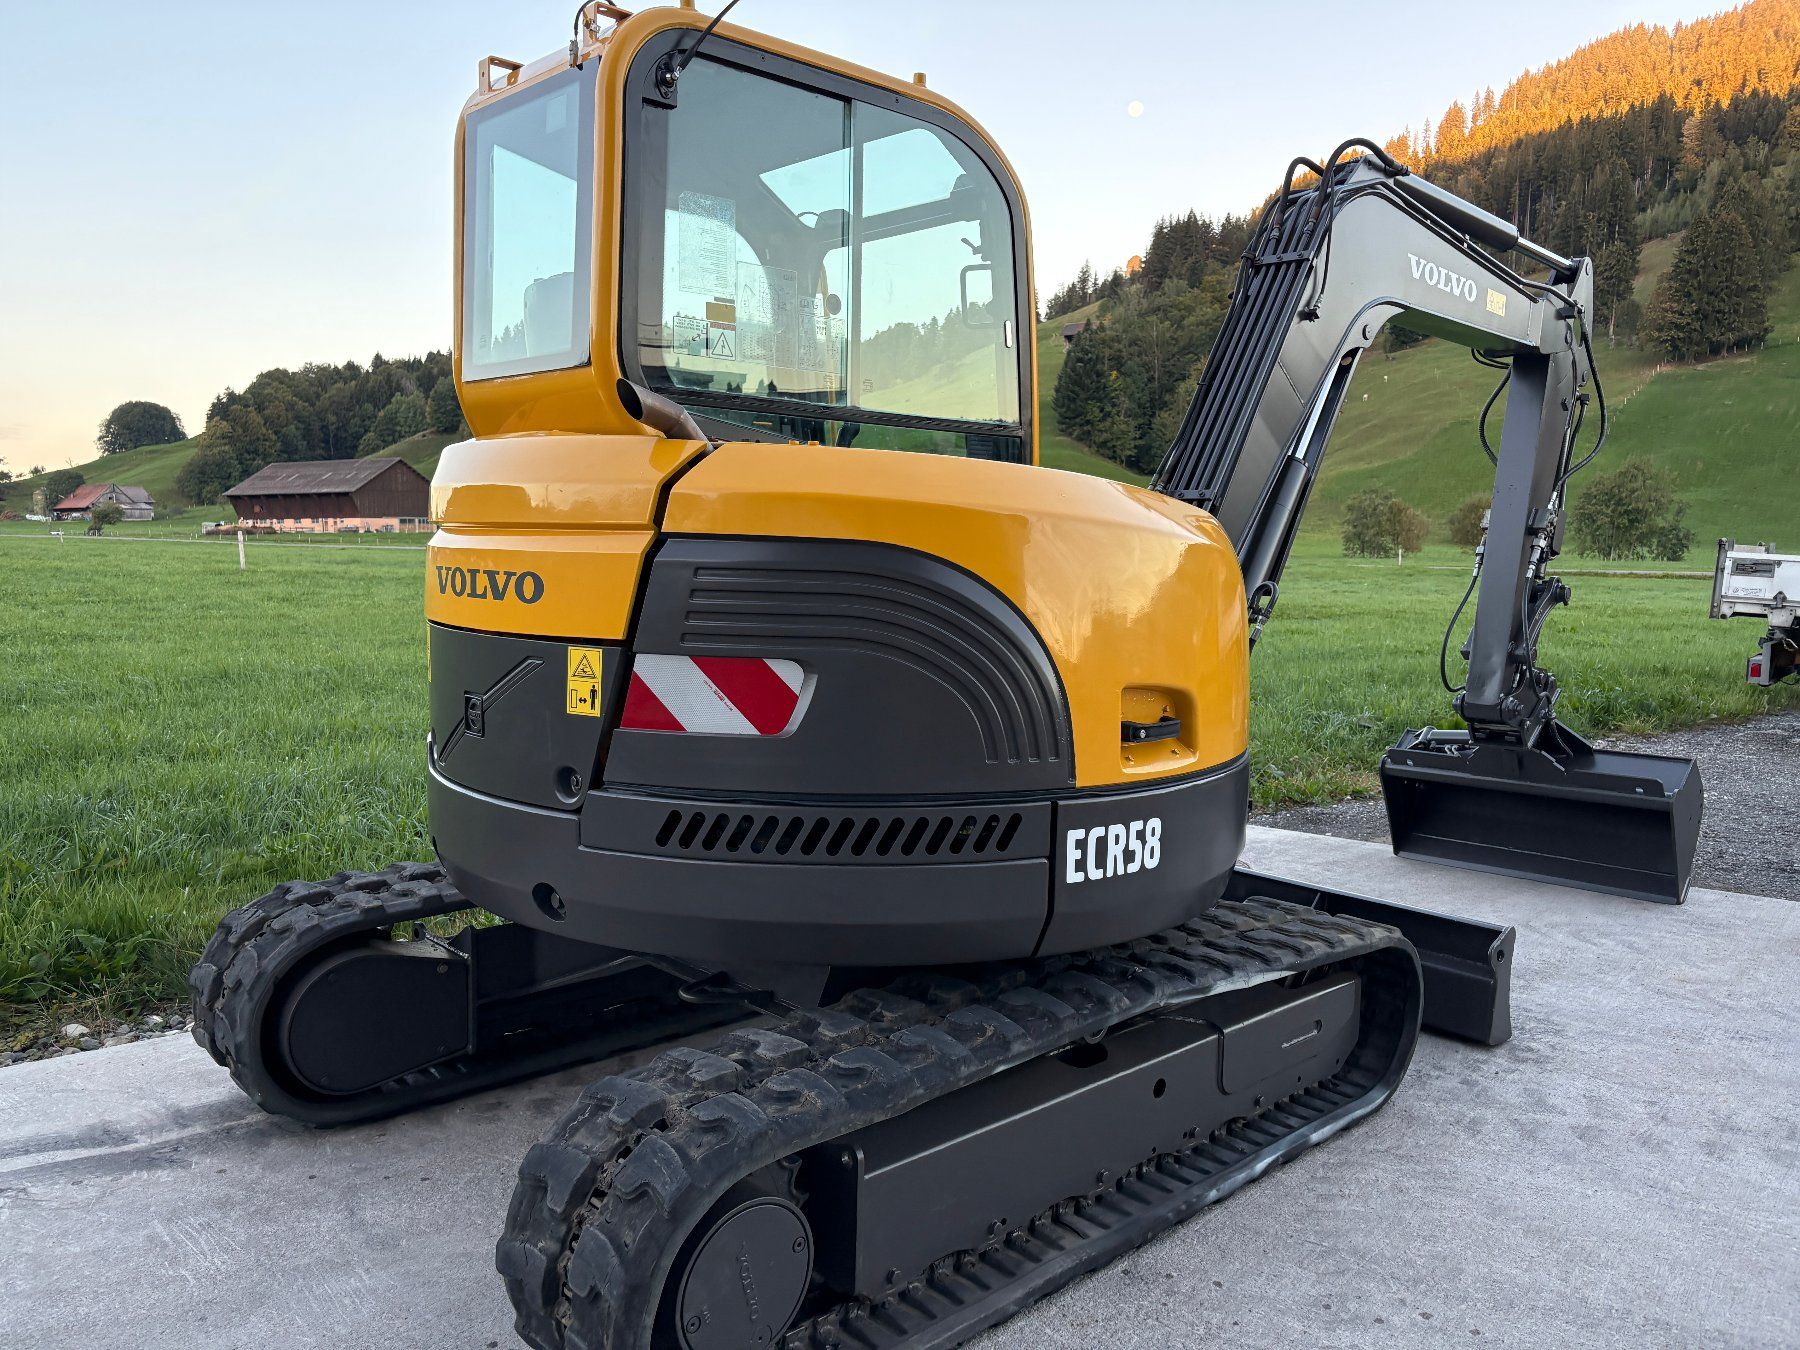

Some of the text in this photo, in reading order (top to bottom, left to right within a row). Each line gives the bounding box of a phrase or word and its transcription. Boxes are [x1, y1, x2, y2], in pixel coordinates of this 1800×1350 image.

[1408, 253, 1477, 302] VOLVO
[436, 566, 544, 604] VOLVO
[1066, 817, 1162, 883] ECR58
